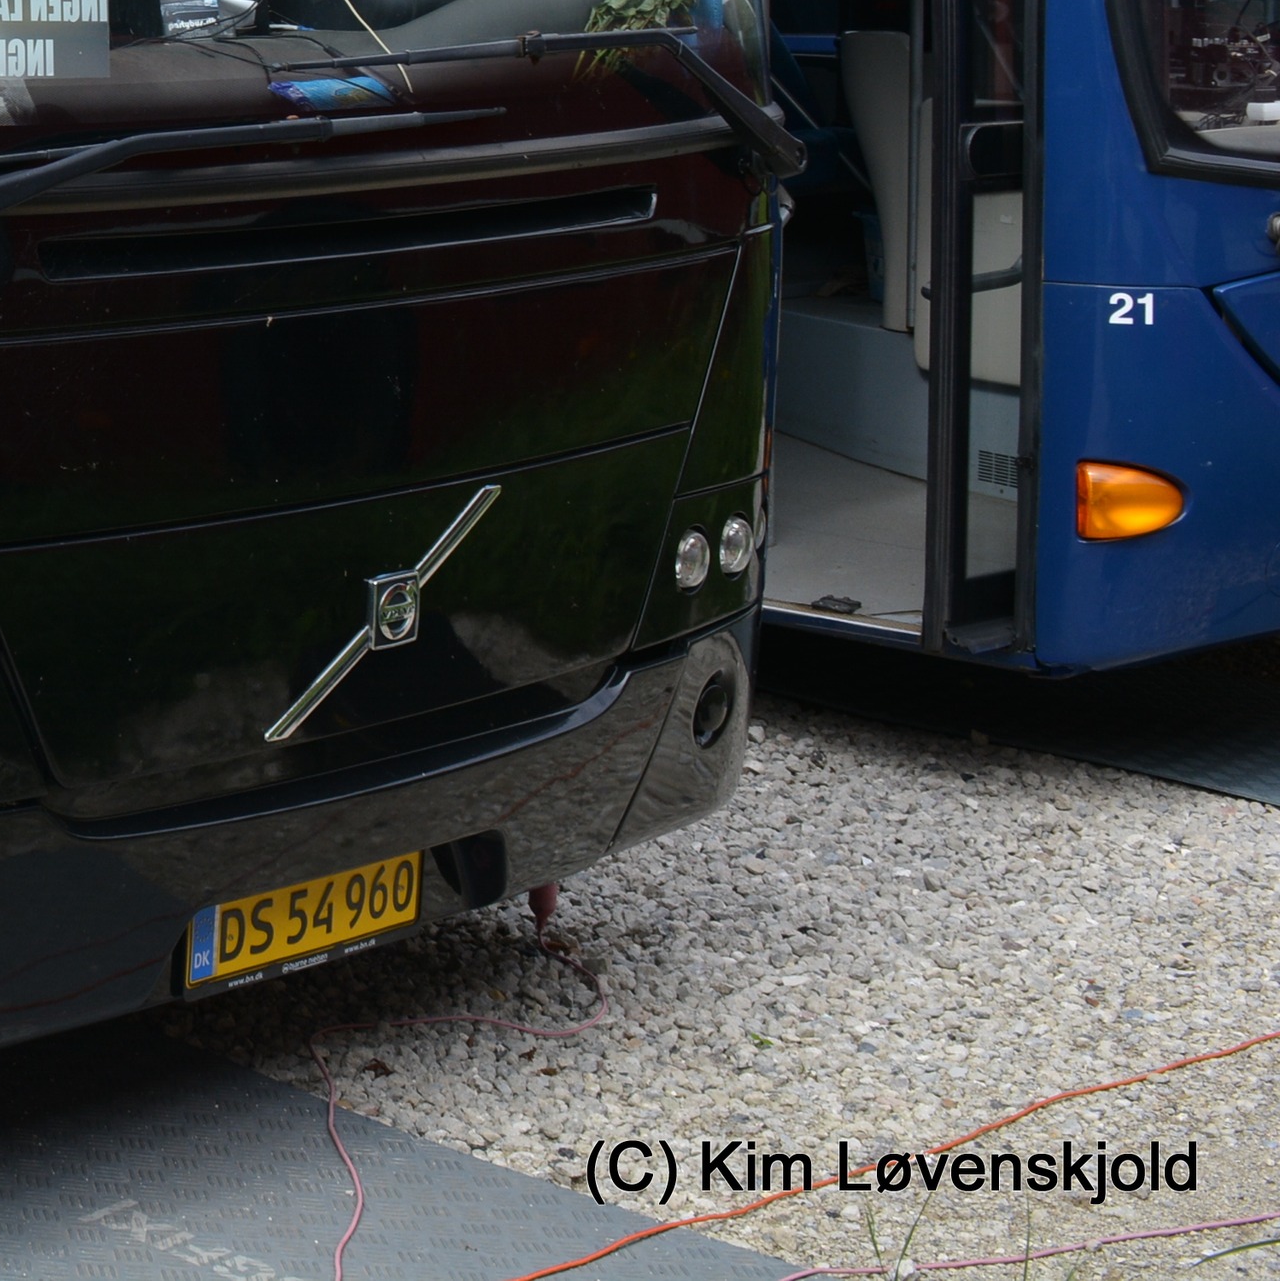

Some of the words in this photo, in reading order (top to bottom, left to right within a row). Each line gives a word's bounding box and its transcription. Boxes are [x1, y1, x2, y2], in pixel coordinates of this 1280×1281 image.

[1108, 292, 1154, 326] 21
[219, 898, 274, 964] DS
[286, 881, 335, 945] 54
[345, 859, 415, 929] 960
[194, 951, 210, 969] DK
